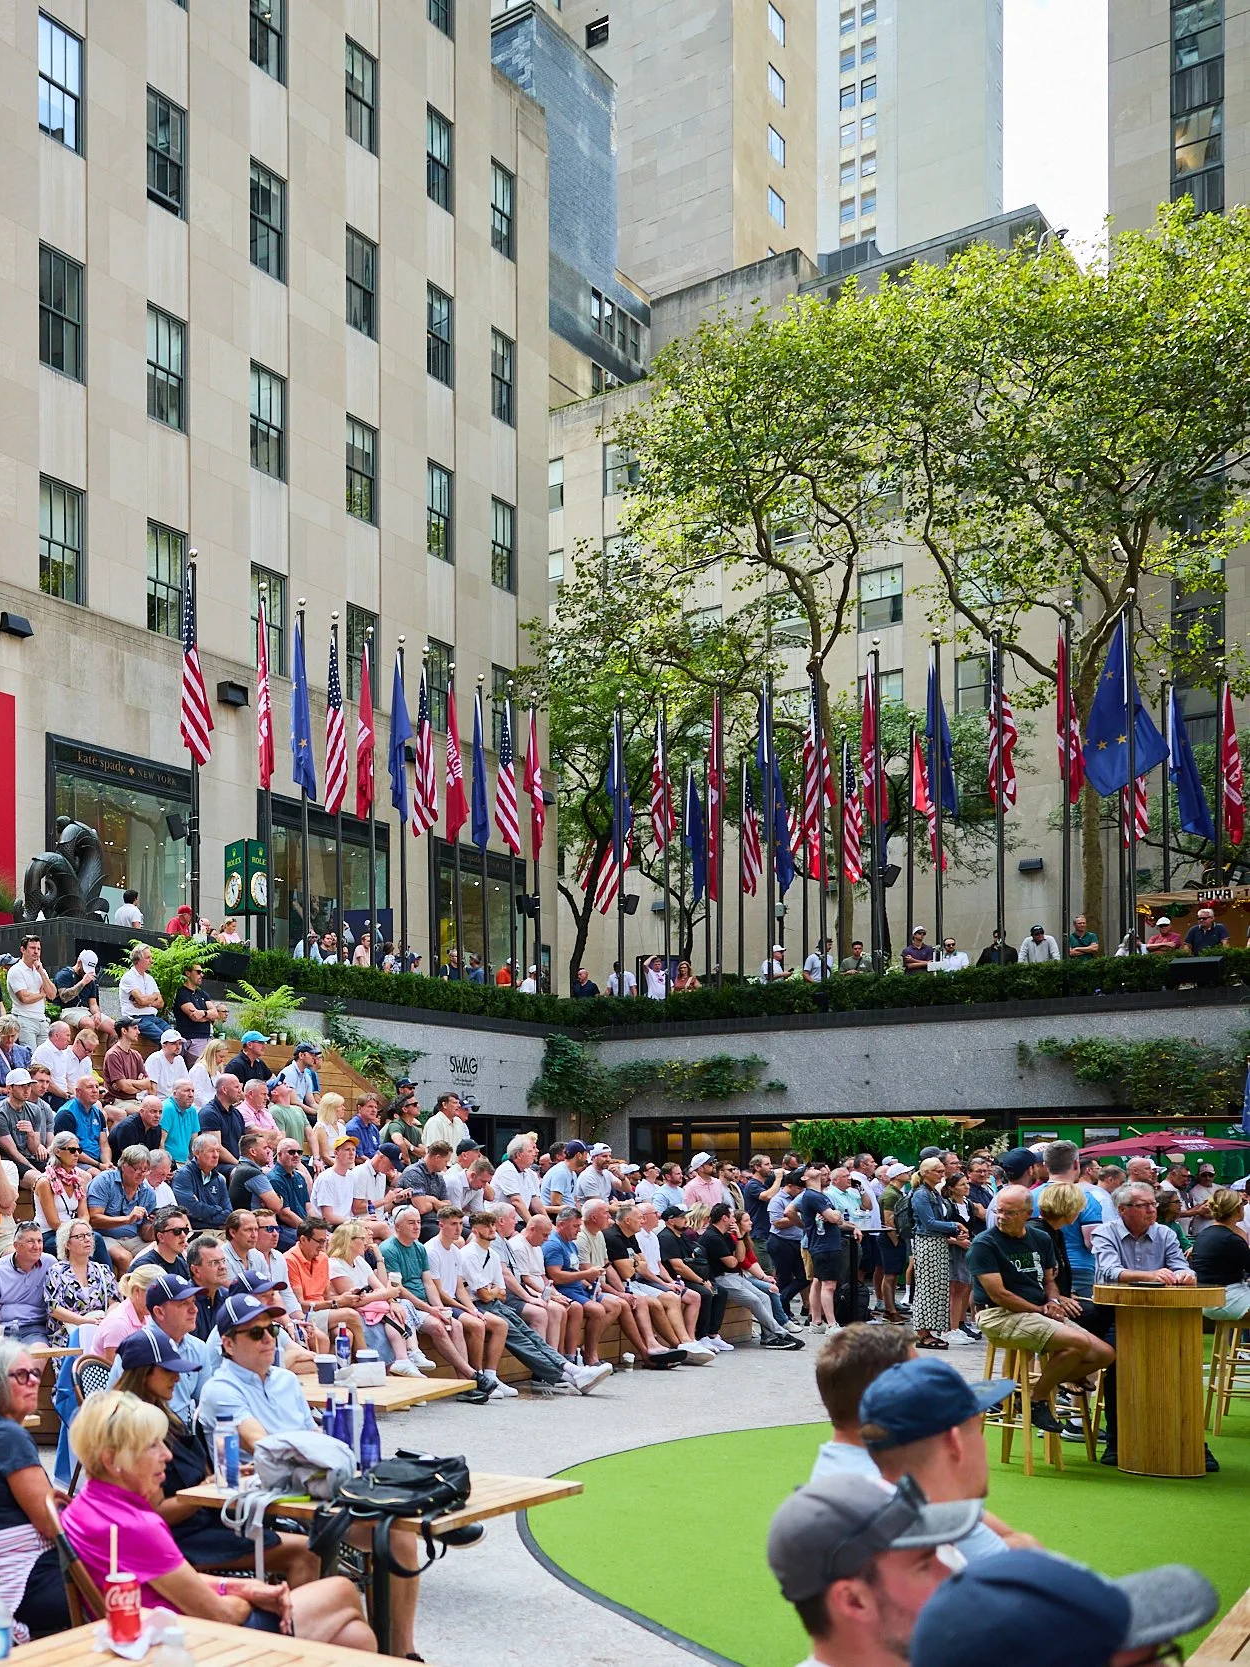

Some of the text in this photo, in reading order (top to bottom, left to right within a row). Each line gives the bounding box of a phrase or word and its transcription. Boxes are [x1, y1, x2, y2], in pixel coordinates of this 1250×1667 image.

[77, 750, 177, 786] kate spade NEW YORK
[226, 856, 267, 868] ROLEX ROLE
[449, 1056, 478, 1074] SWAG
